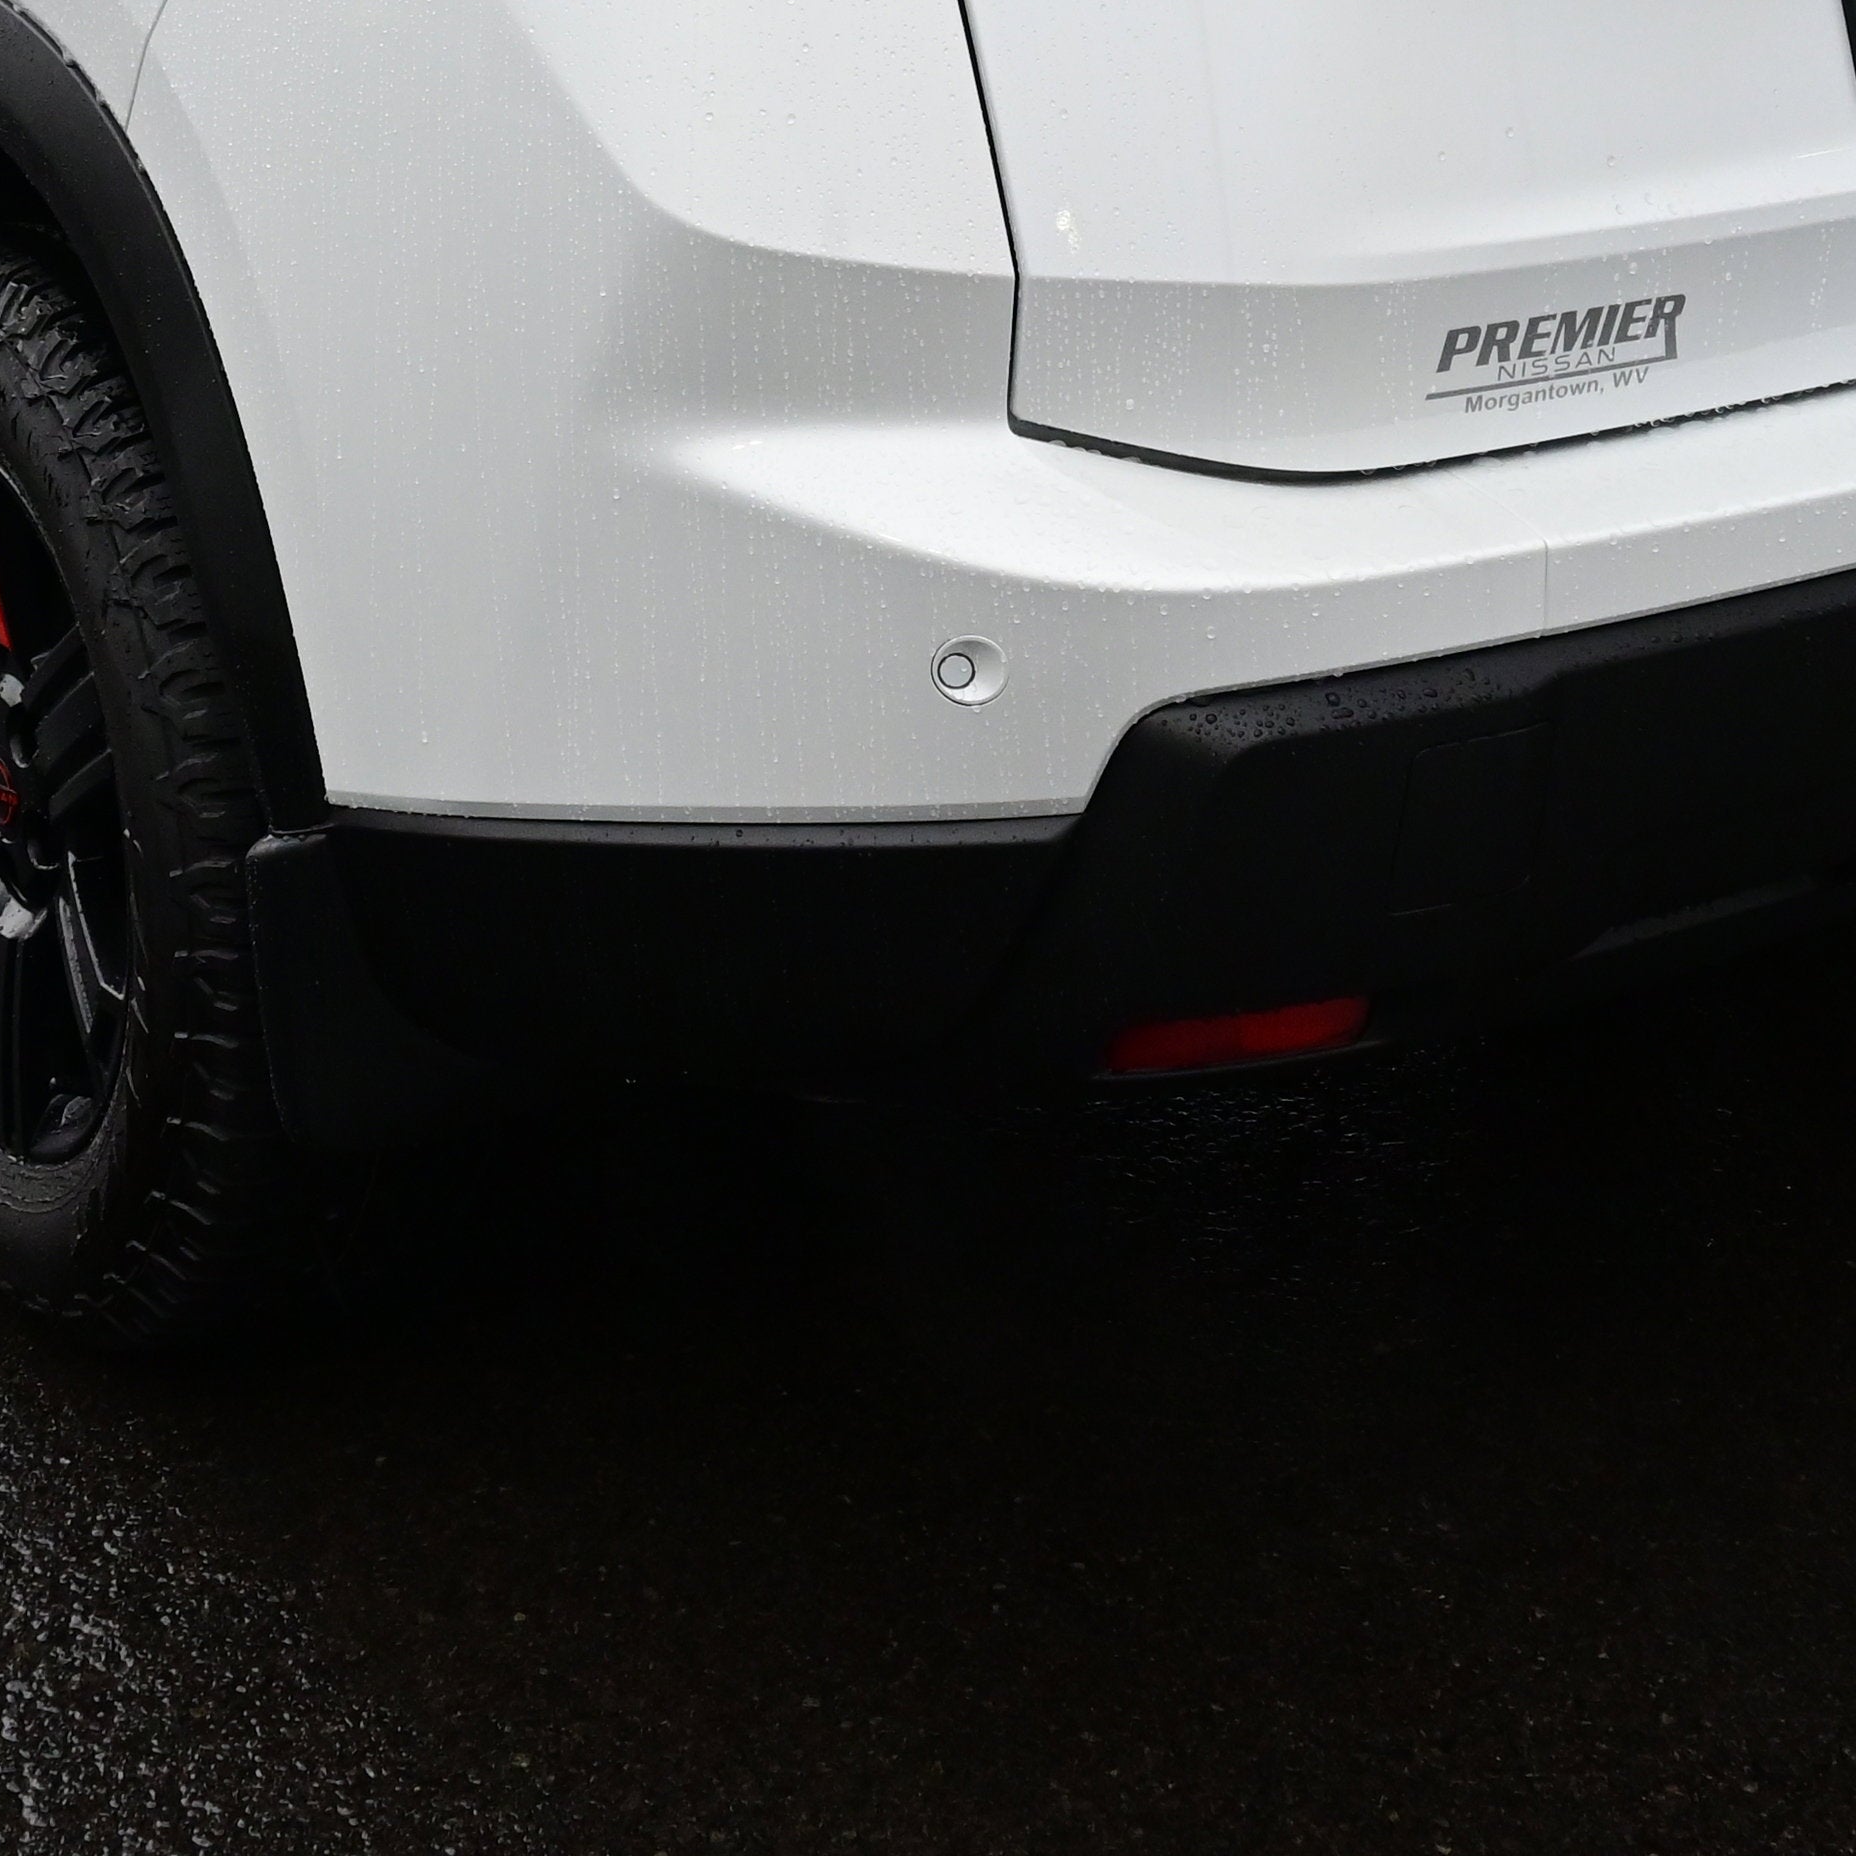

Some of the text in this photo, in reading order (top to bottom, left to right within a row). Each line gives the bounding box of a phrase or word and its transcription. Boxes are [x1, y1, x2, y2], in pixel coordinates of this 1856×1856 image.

[1435, 294, 1687, 374] PREMIER
[1497, 347, 1616, 382] NISSAN
[1463, 366, 1650, 414] Morgantown, WV
